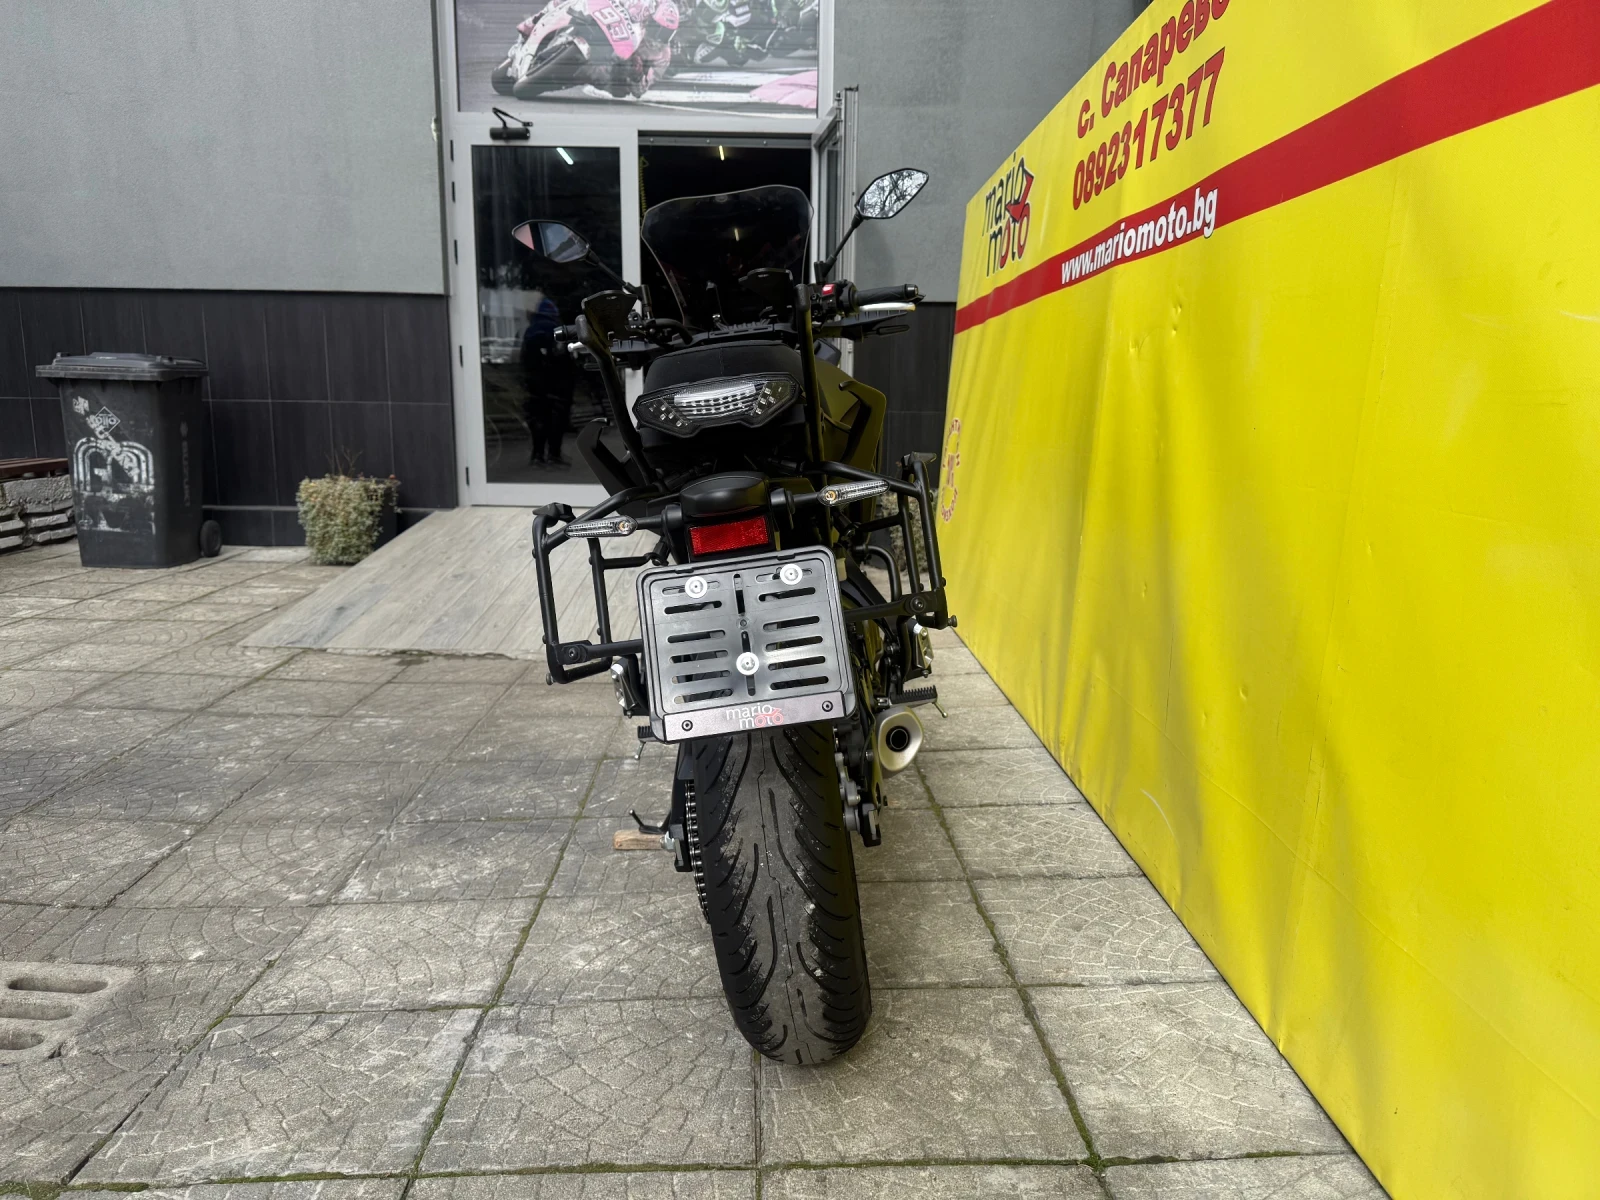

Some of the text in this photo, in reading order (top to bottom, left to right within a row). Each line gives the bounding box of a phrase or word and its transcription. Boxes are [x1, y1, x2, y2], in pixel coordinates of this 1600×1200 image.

[1072, 47, 1225, 210] 0892317377
[982, 151, 1024, 236] mario
[986, 202, 1030, 277] moto
[1061, 187, 1218, 284] www.mariomoto.bg
[726, 703, 772, 720] mario
[739, 712, 783, 729] moto
